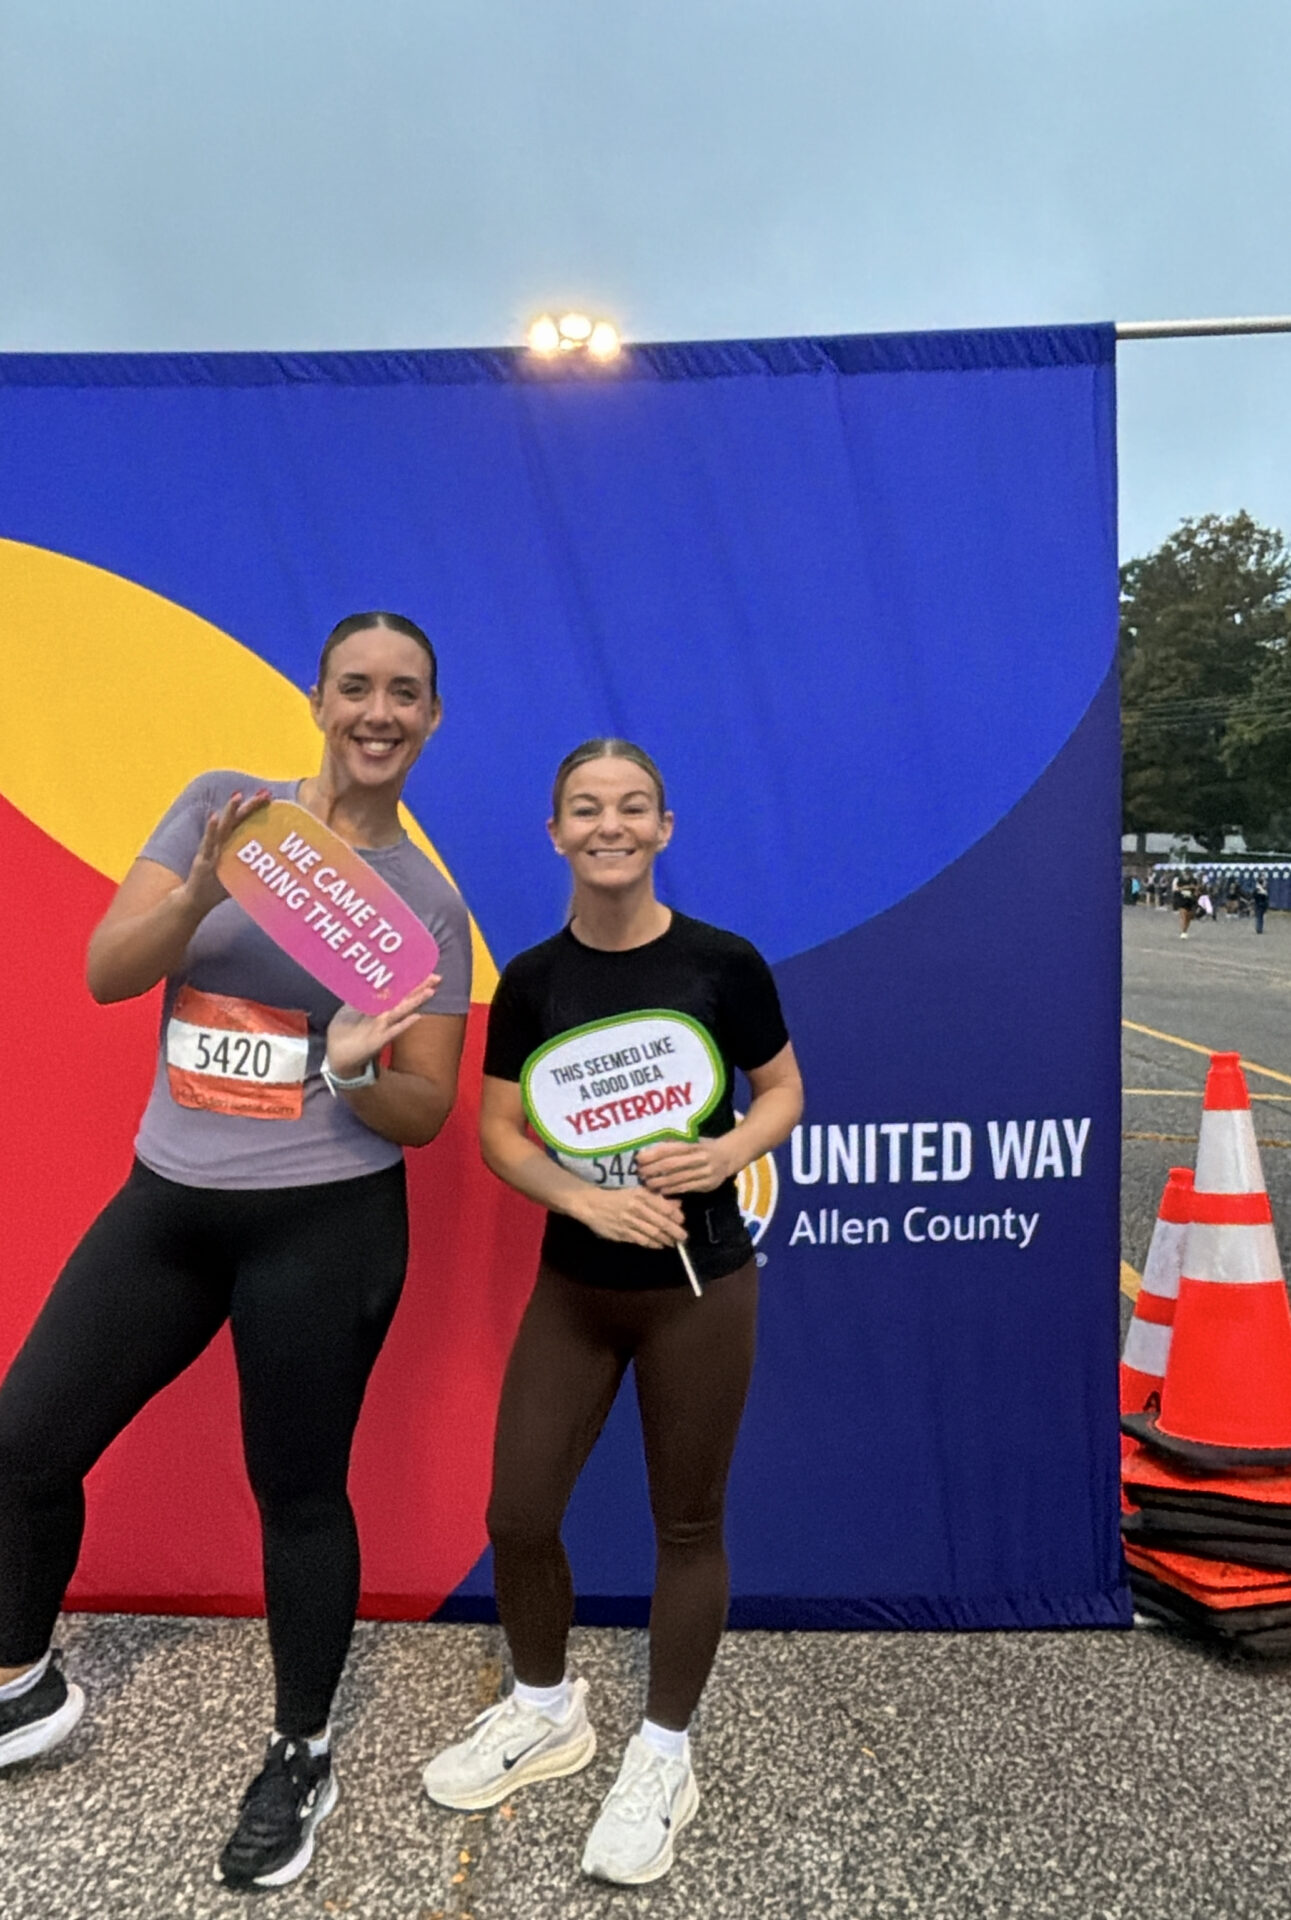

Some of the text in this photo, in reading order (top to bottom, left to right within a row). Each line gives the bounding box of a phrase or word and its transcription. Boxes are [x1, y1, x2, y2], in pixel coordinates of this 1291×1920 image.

[236, 840, 394, 990] BRING THE FUN
[278, 831, 403, 954] WE CAME TO
[194, 1033, 271, 1078] 5420
[550, 1036, 676, 1086] THIS SEEMED LIKE
[565, 1082, 693, 1135] YESTERDAY
[579, 1064, 664, 1102] A GOOD IDEA
[790, 1117, 1091, 1185] UNITED WAY
[788, 1206, 1040, 1249] Allen County
